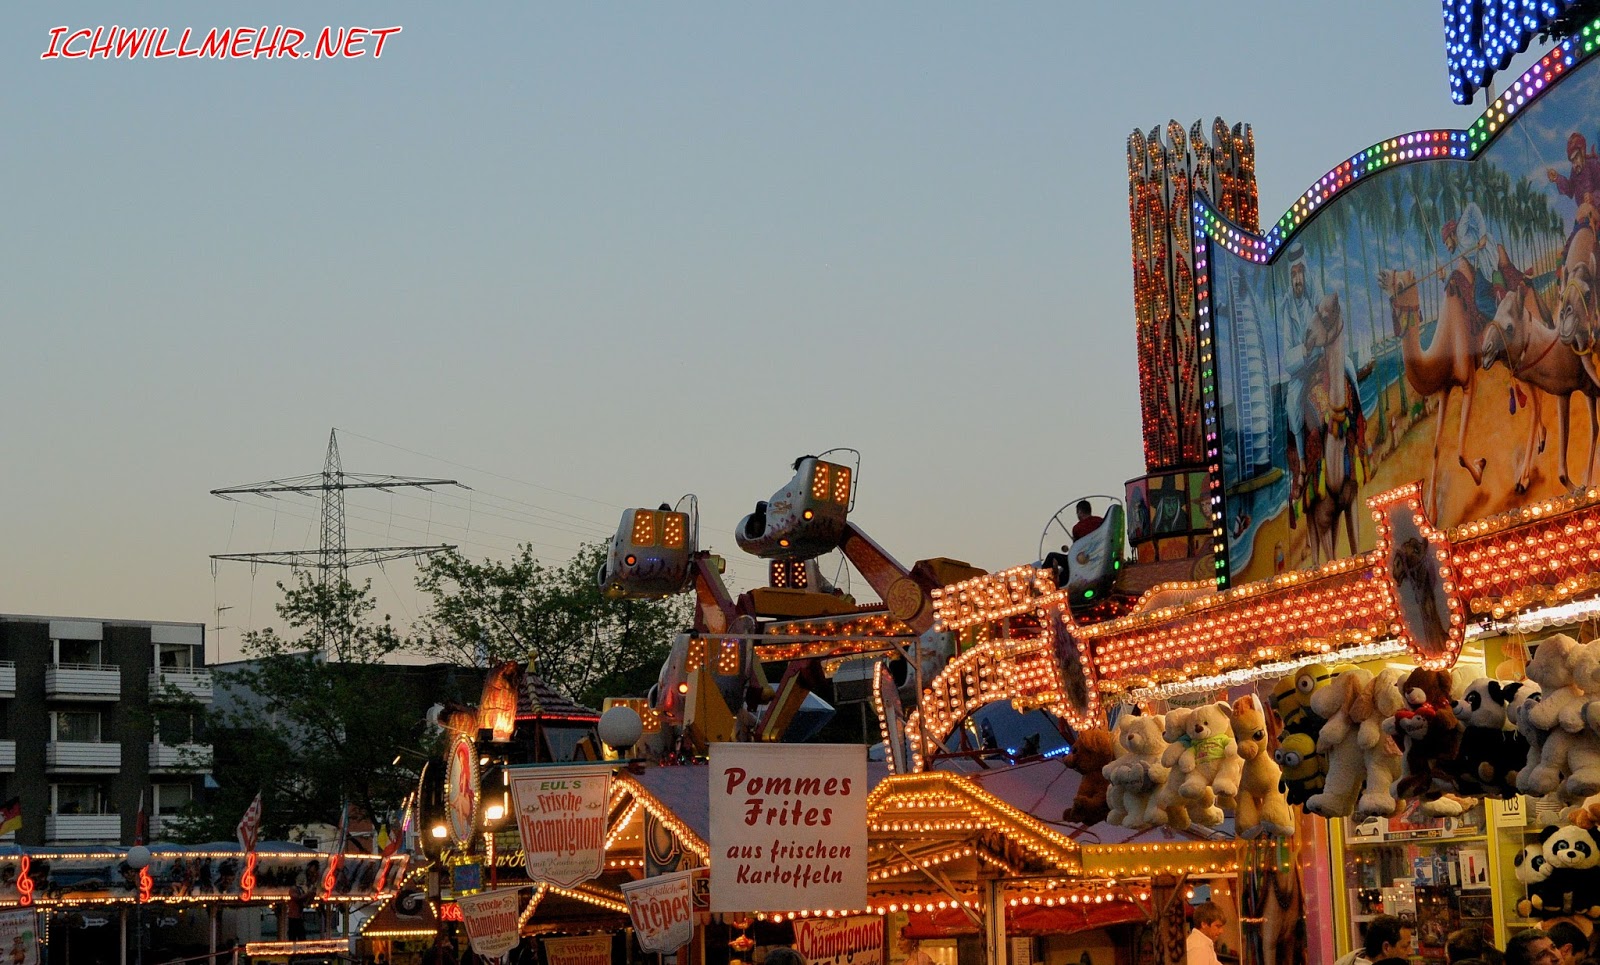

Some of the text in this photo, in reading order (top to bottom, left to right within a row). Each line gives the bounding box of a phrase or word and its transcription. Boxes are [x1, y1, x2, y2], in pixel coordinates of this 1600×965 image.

[724, 767, 851, 796] Pommes
[537, 792, 581, 814] Frische
[744, 798, 833, 826] Frites
[521, 812, 604, 857] Champignons
[726, 839, 851, 864] aus frischen
[736, 864, 843, 888] Kartoffeln
[476, 899, 503, 913] Frische
[631, 894, 690, 932] Crêpes
[466, 910, 518, 938] Champignons
[800, 919, 882, 963] Champignons
